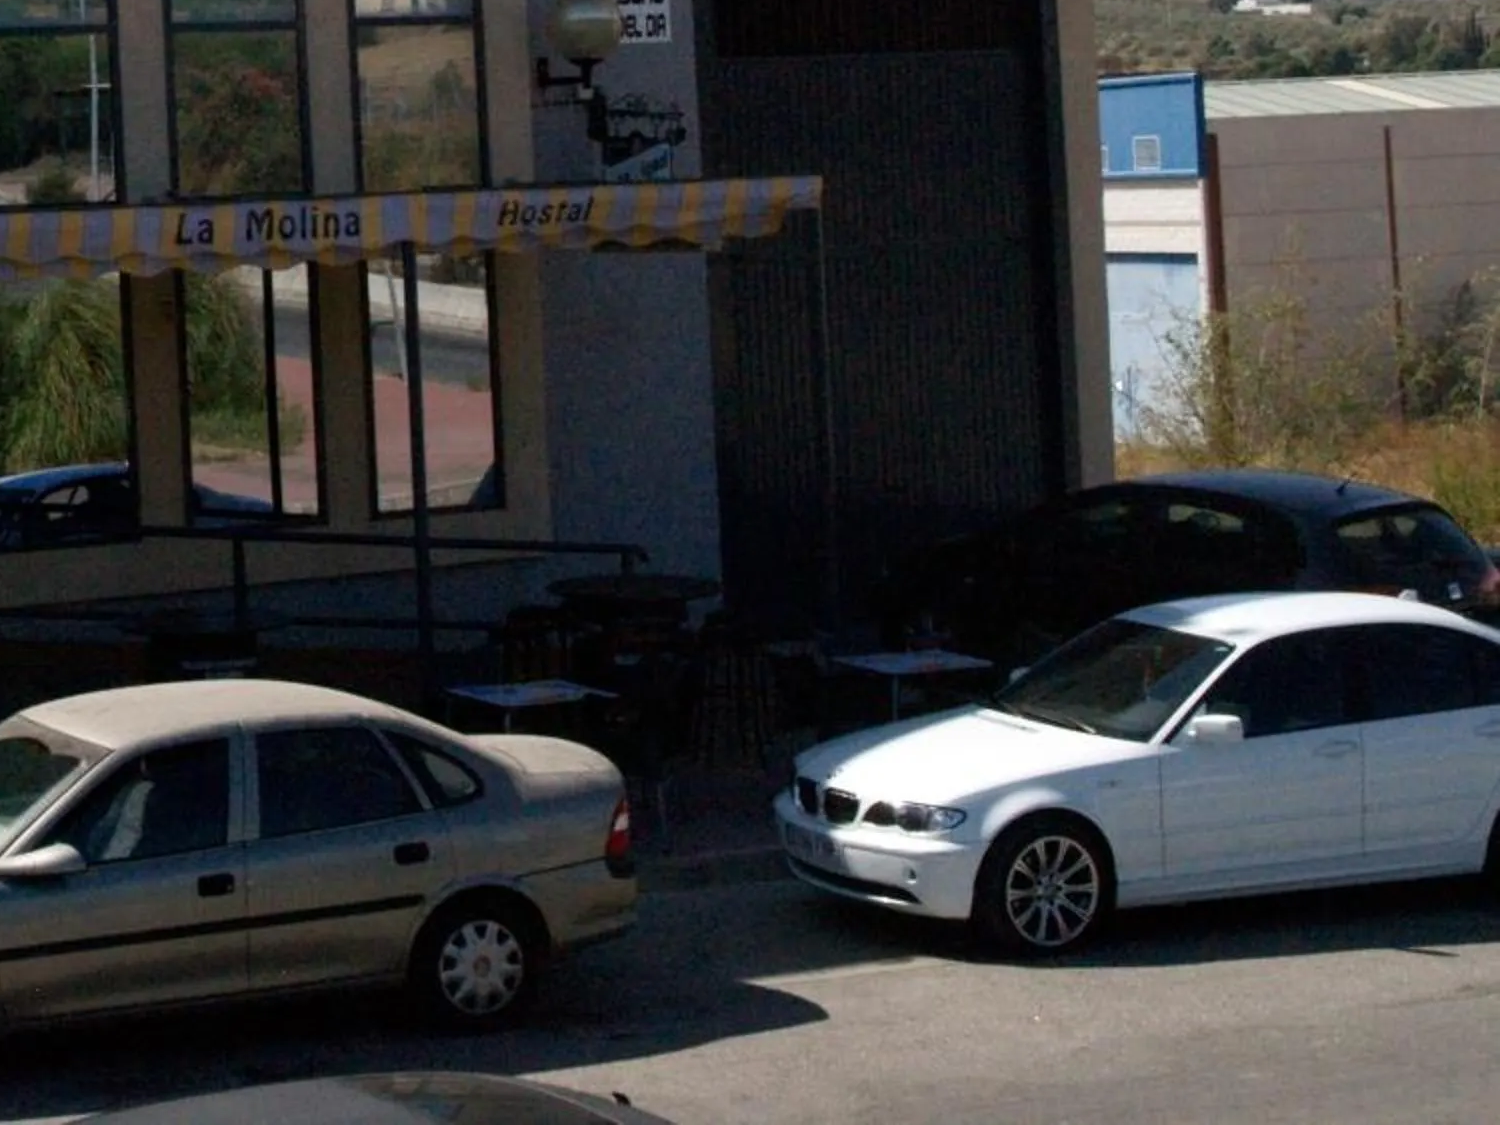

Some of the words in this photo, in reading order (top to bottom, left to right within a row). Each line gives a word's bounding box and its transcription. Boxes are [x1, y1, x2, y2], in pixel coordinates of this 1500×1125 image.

[620, 14, 643, 38] EL
[173, 207, 215, 248] La
[244, 205, 363, 243] Molina
[497, 196, 594, 227] Hostal
